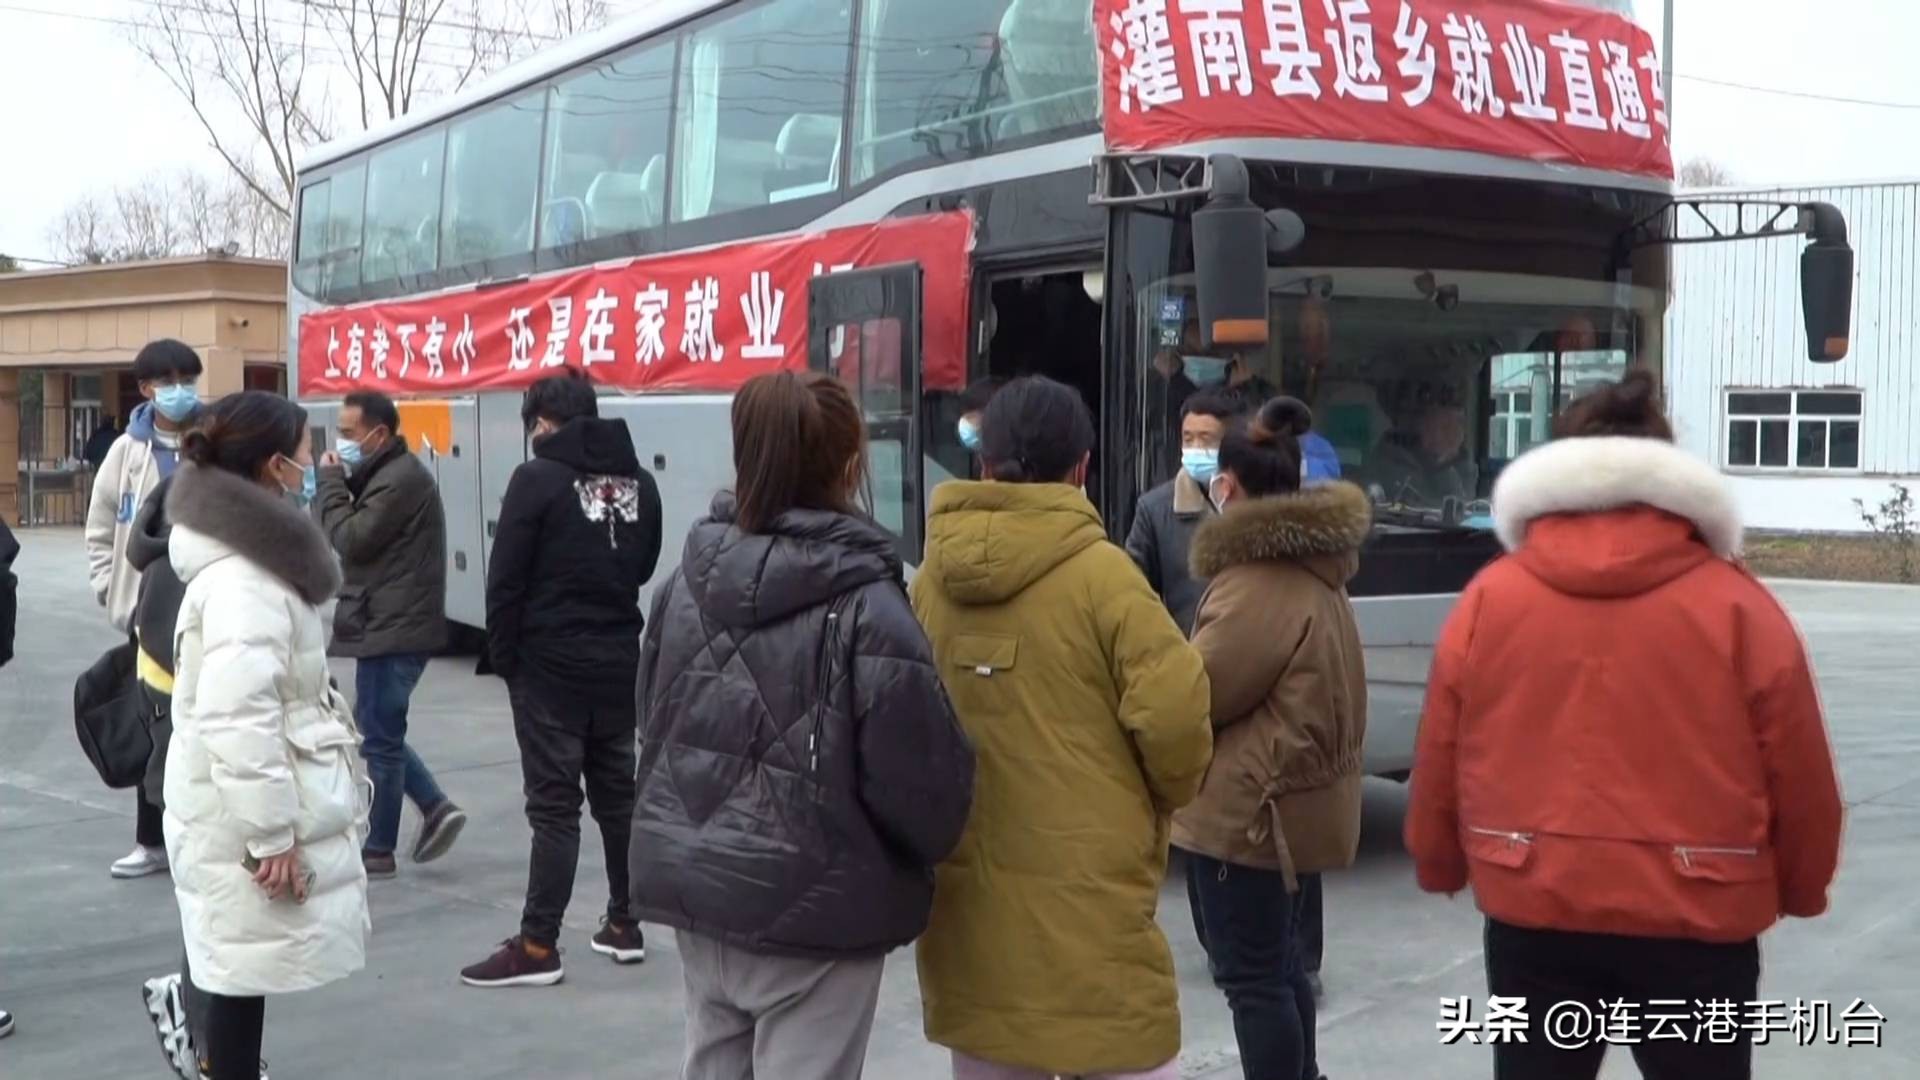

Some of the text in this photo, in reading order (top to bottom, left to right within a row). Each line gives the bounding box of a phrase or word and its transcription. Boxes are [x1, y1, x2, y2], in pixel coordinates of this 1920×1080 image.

[325, 262, 855, 379] 上有老下有小 还是在家就业
